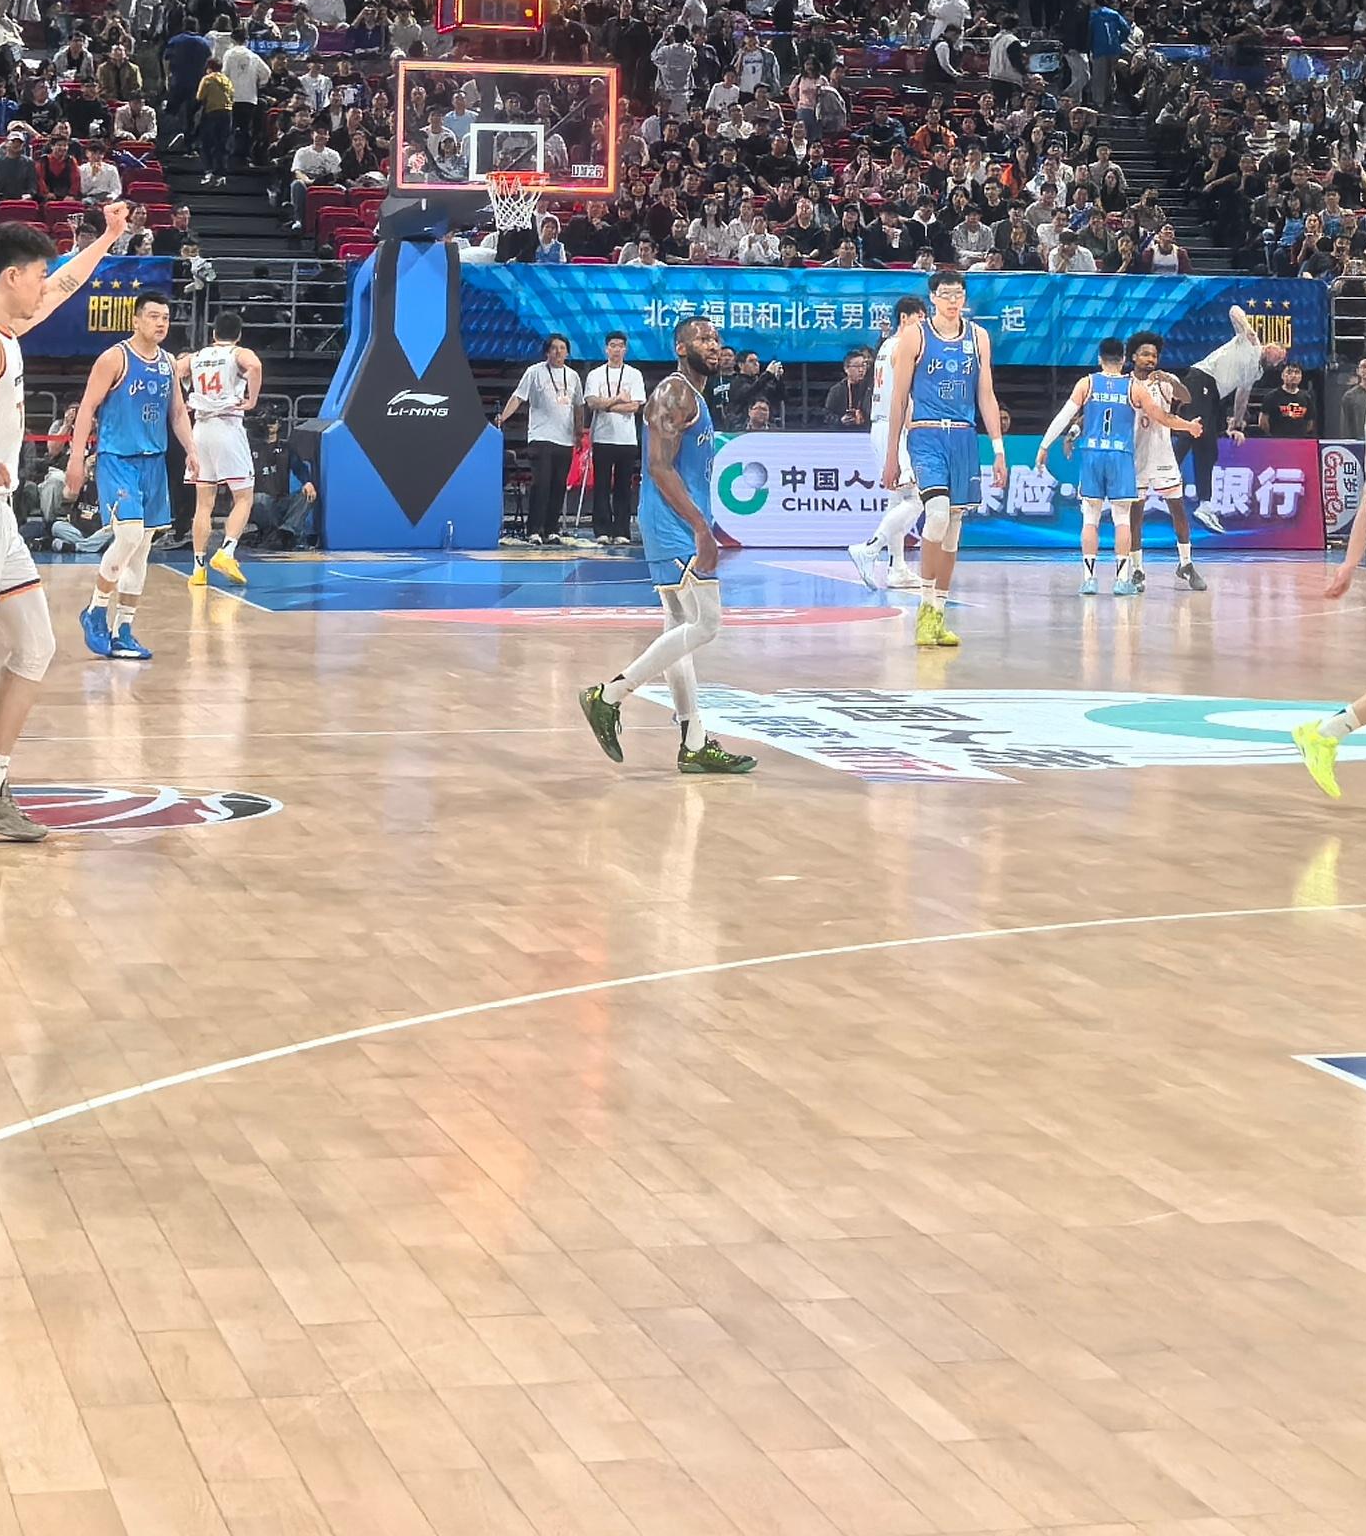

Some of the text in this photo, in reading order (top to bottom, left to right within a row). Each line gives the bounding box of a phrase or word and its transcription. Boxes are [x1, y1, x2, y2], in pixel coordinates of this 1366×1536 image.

[87, 295, 137, 332] BEIJIN
[197, 371, 223, 395] 14
[386, 405, 449, 417] LI-NING
[781, 465, 876, 494] 中国人
[781, 497, 853, 513] CHINA
